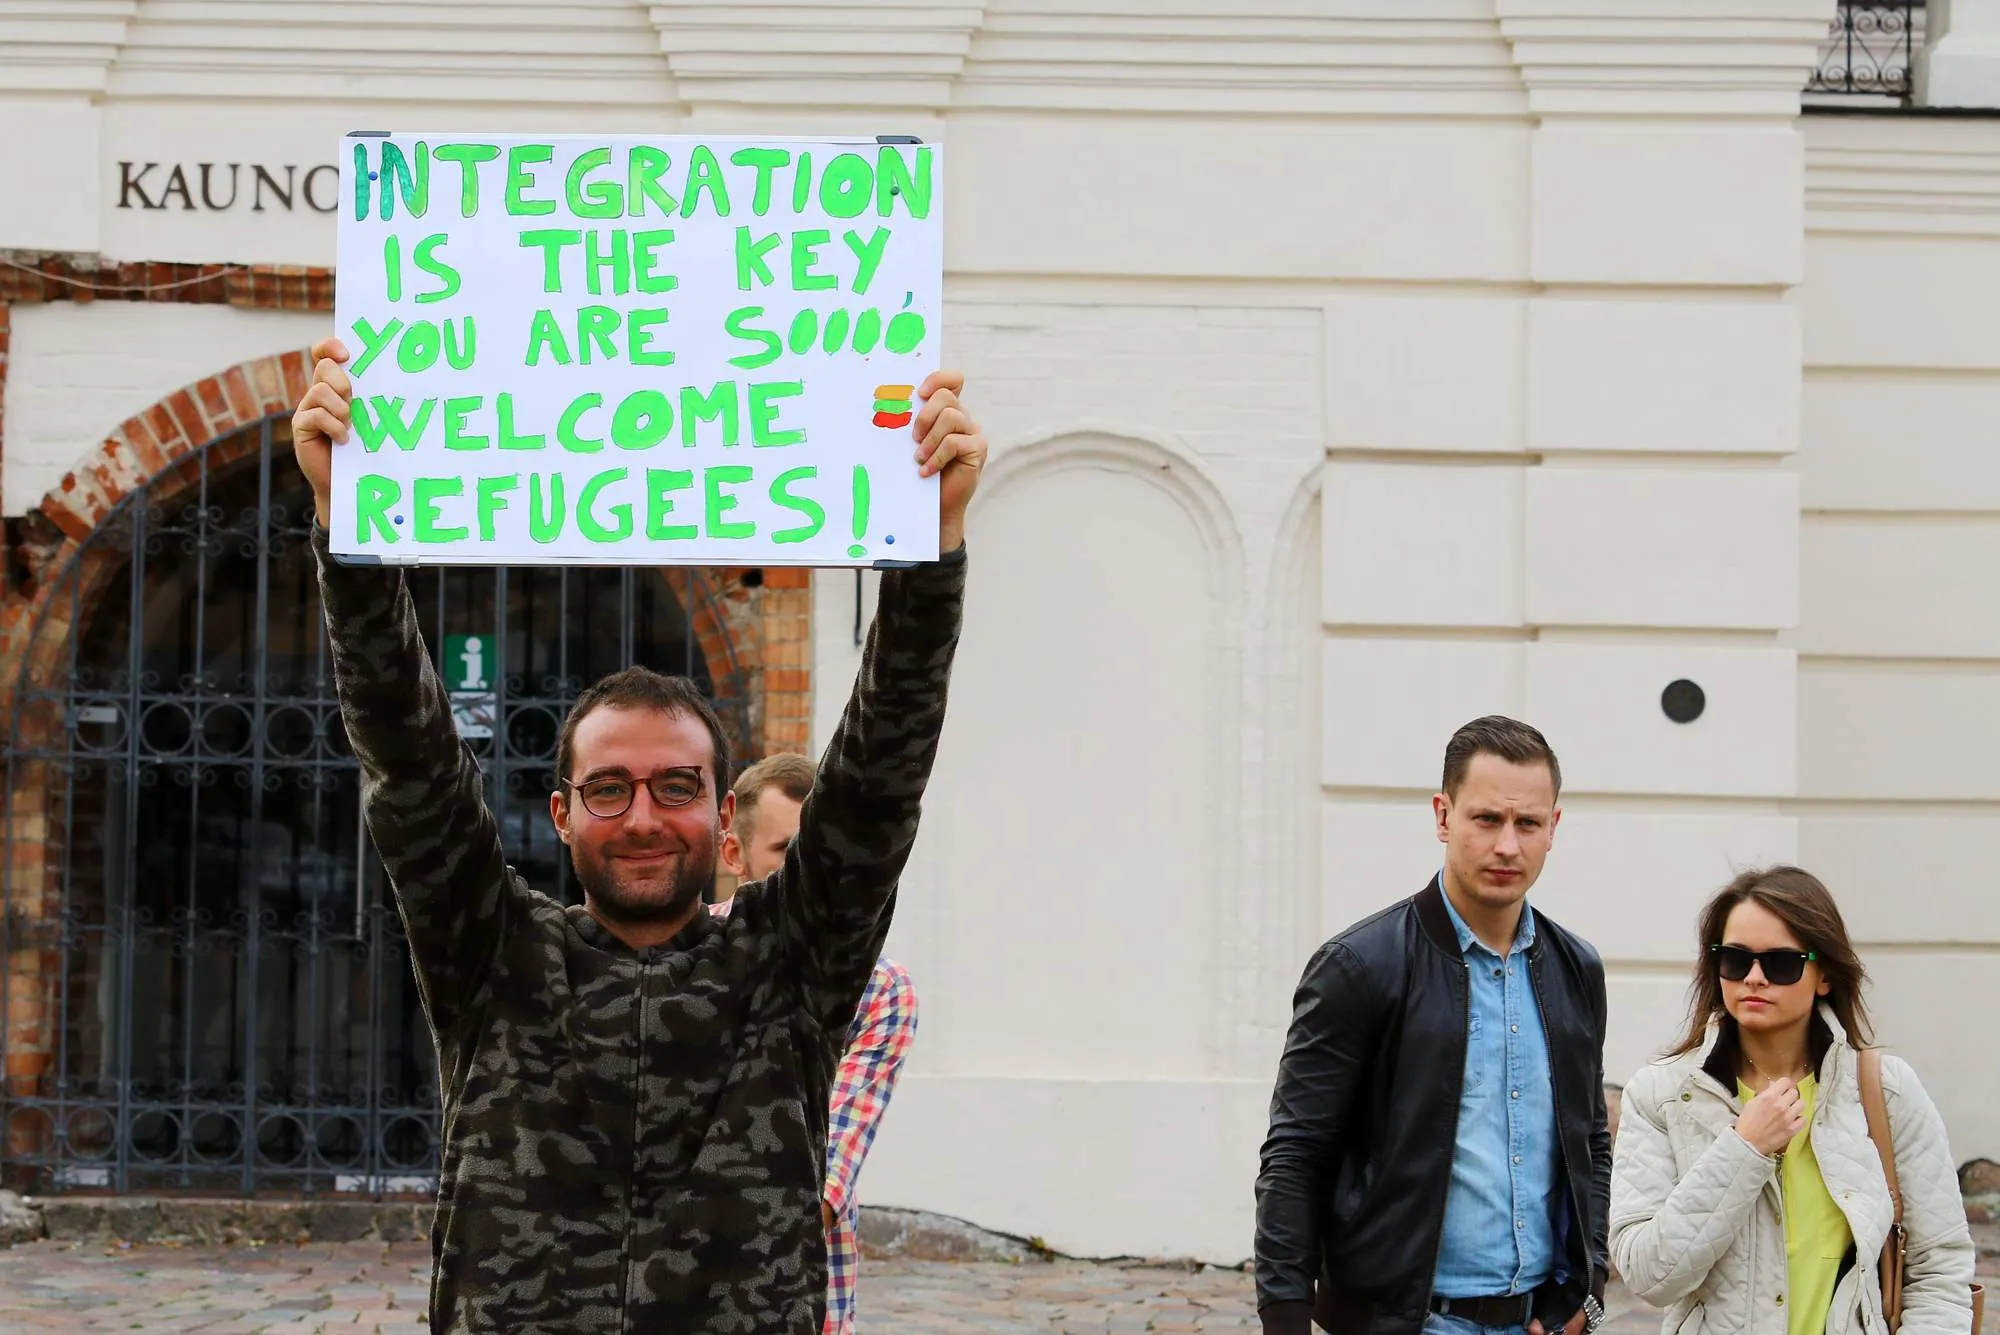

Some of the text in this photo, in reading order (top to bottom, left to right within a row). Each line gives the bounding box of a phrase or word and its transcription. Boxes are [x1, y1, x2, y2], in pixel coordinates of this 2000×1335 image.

[116, 161, 339, 212] KAUNO
[353, 141, 932, 221] INTEGRATION
[384, 233, 461, 303] IS
[519, 229, 678, 295] THE
[349, 315, 476, 378] YOU
[525, 305, 675, 366] ARE
[350, 379, 807, 453] WELCOME
